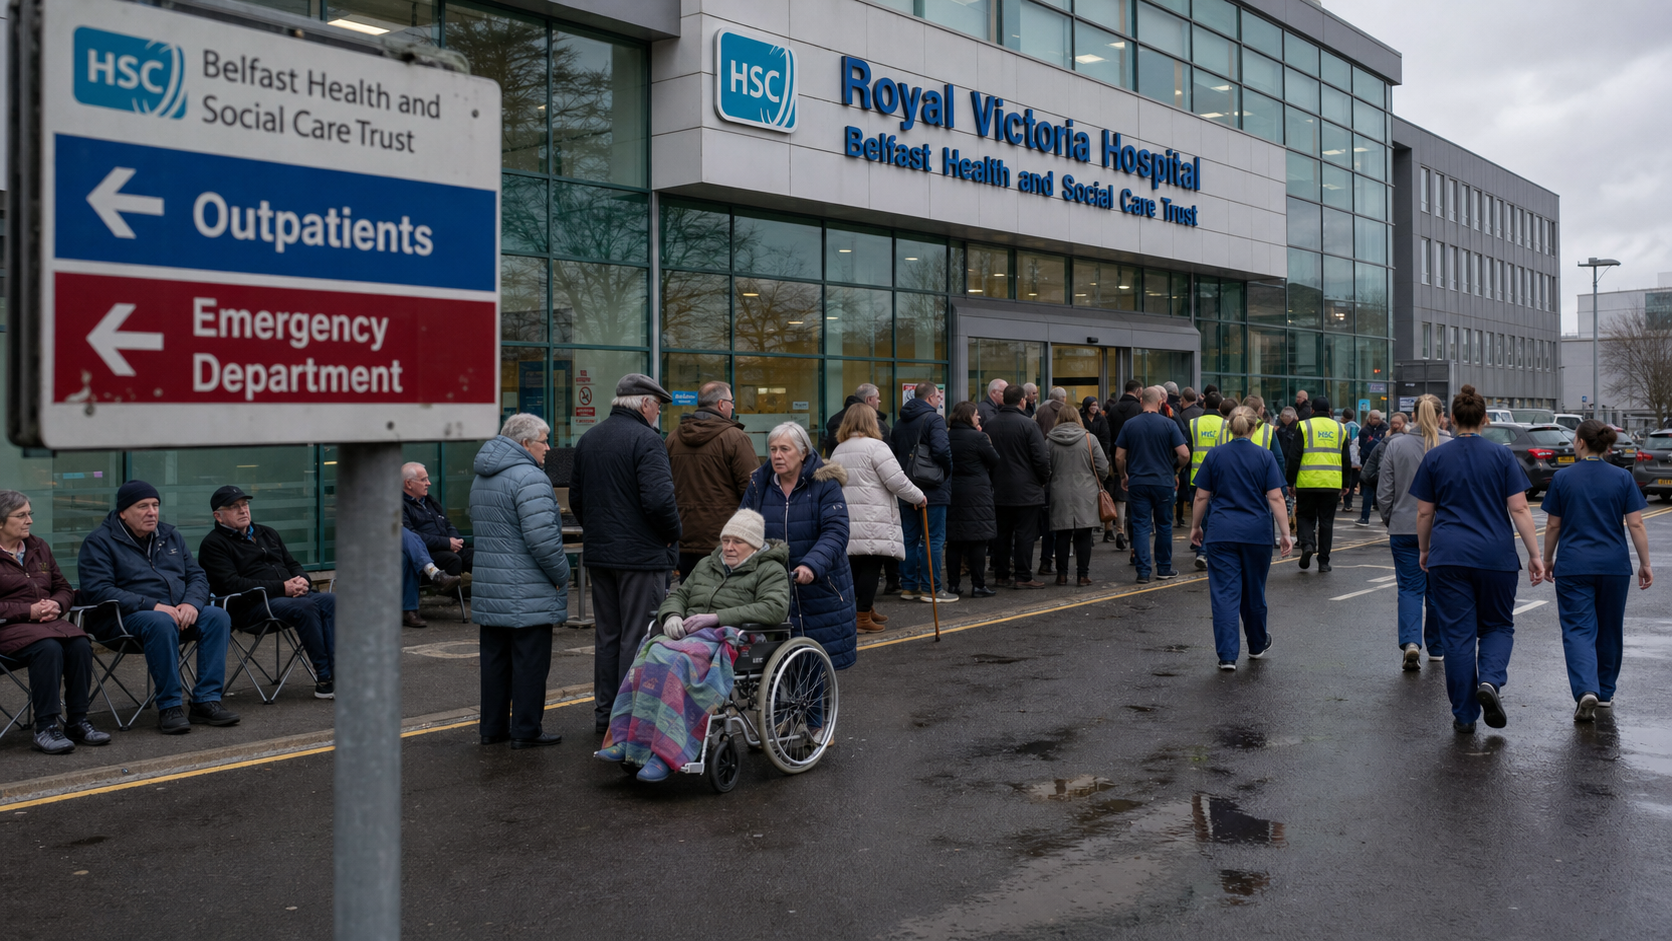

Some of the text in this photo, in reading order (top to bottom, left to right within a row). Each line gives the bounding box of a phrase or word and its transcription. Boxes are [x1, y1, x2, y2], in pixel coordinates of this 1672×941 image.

[88, 49, 164, 94] HSC
[203, 49, 441, 119] Belfast Health and
[730, 59, 780, 103] HSC
[202, 94, 415, 154] Social Care Trust
[842, 55, 1201, 190] Royal Victoria Hospital
[845, 125, 1199, 226] Belfast Health and Social Care Trust
[193, 192, 434, 256] Outpatients
[193, 297, 389, 352] Emergency
[193, 352, 403, 401] Department
